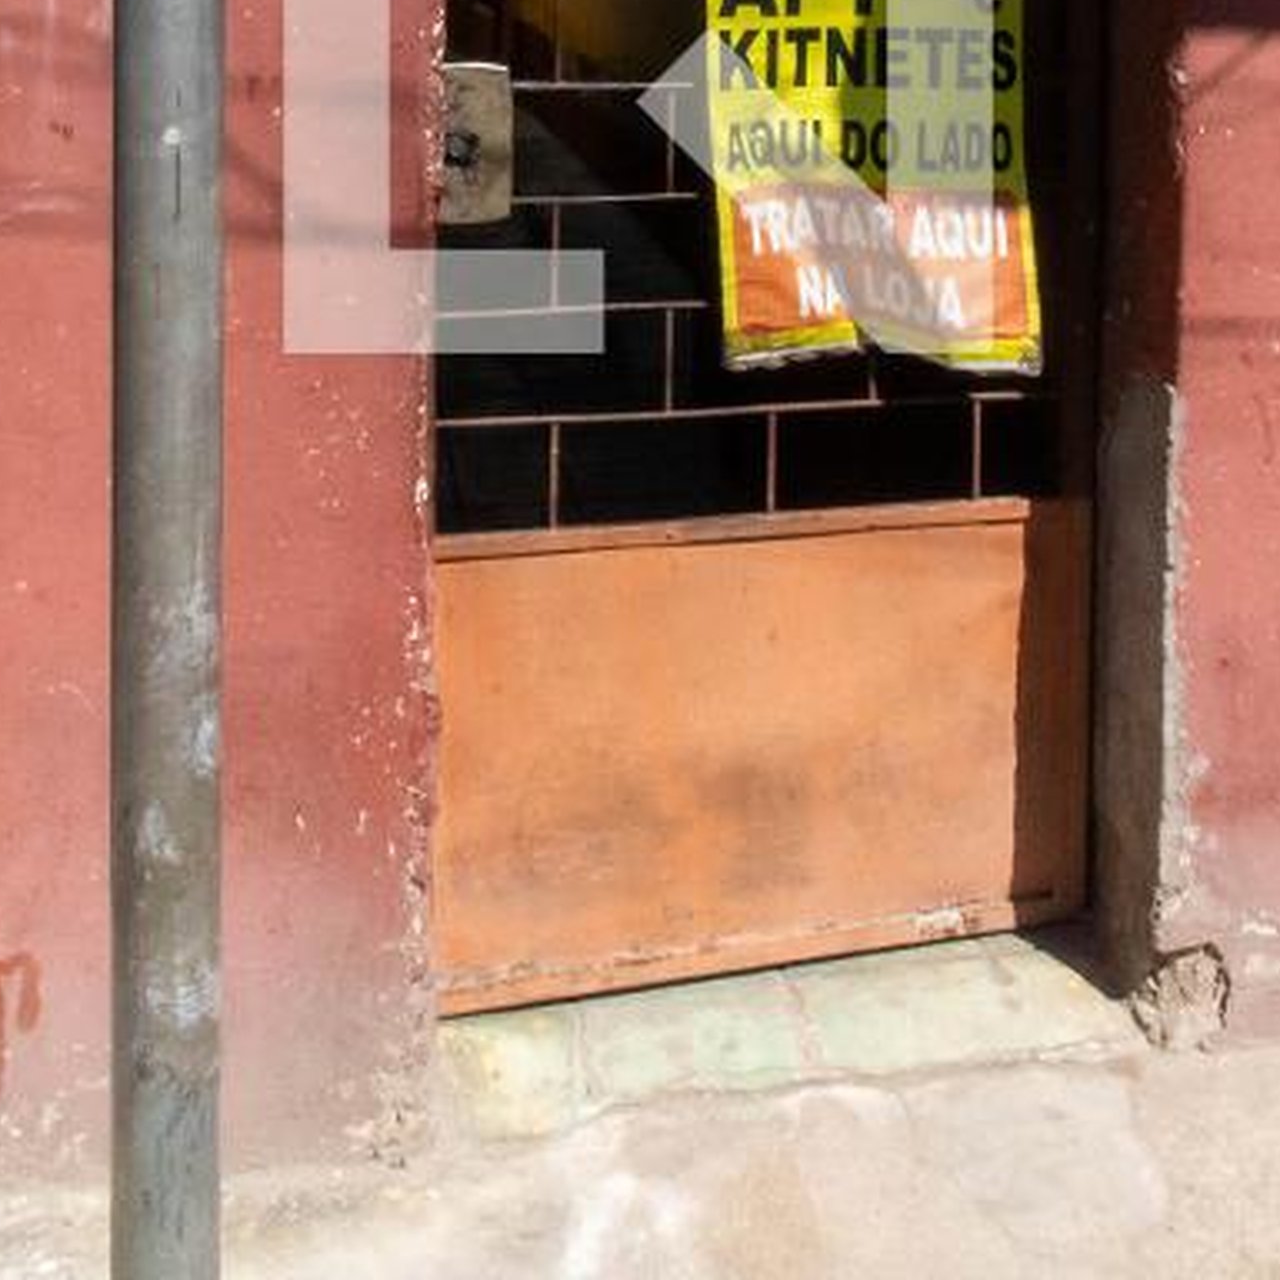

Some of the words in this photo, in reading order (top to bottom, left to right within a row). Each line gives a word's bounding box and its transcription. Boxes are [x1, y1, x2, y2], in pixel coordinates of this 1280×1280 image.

[720, 26, 1018, 92] KITNETES
[727, 120, 824, 172] AQUI
[842, 120, 899, 171] DO
[918, 122, 1013, 172] LADO
[742, 195, 896, 260] TRATAR
[907, 205, 1009, 261] AQUI
[797, 264, 853, 320] NA
